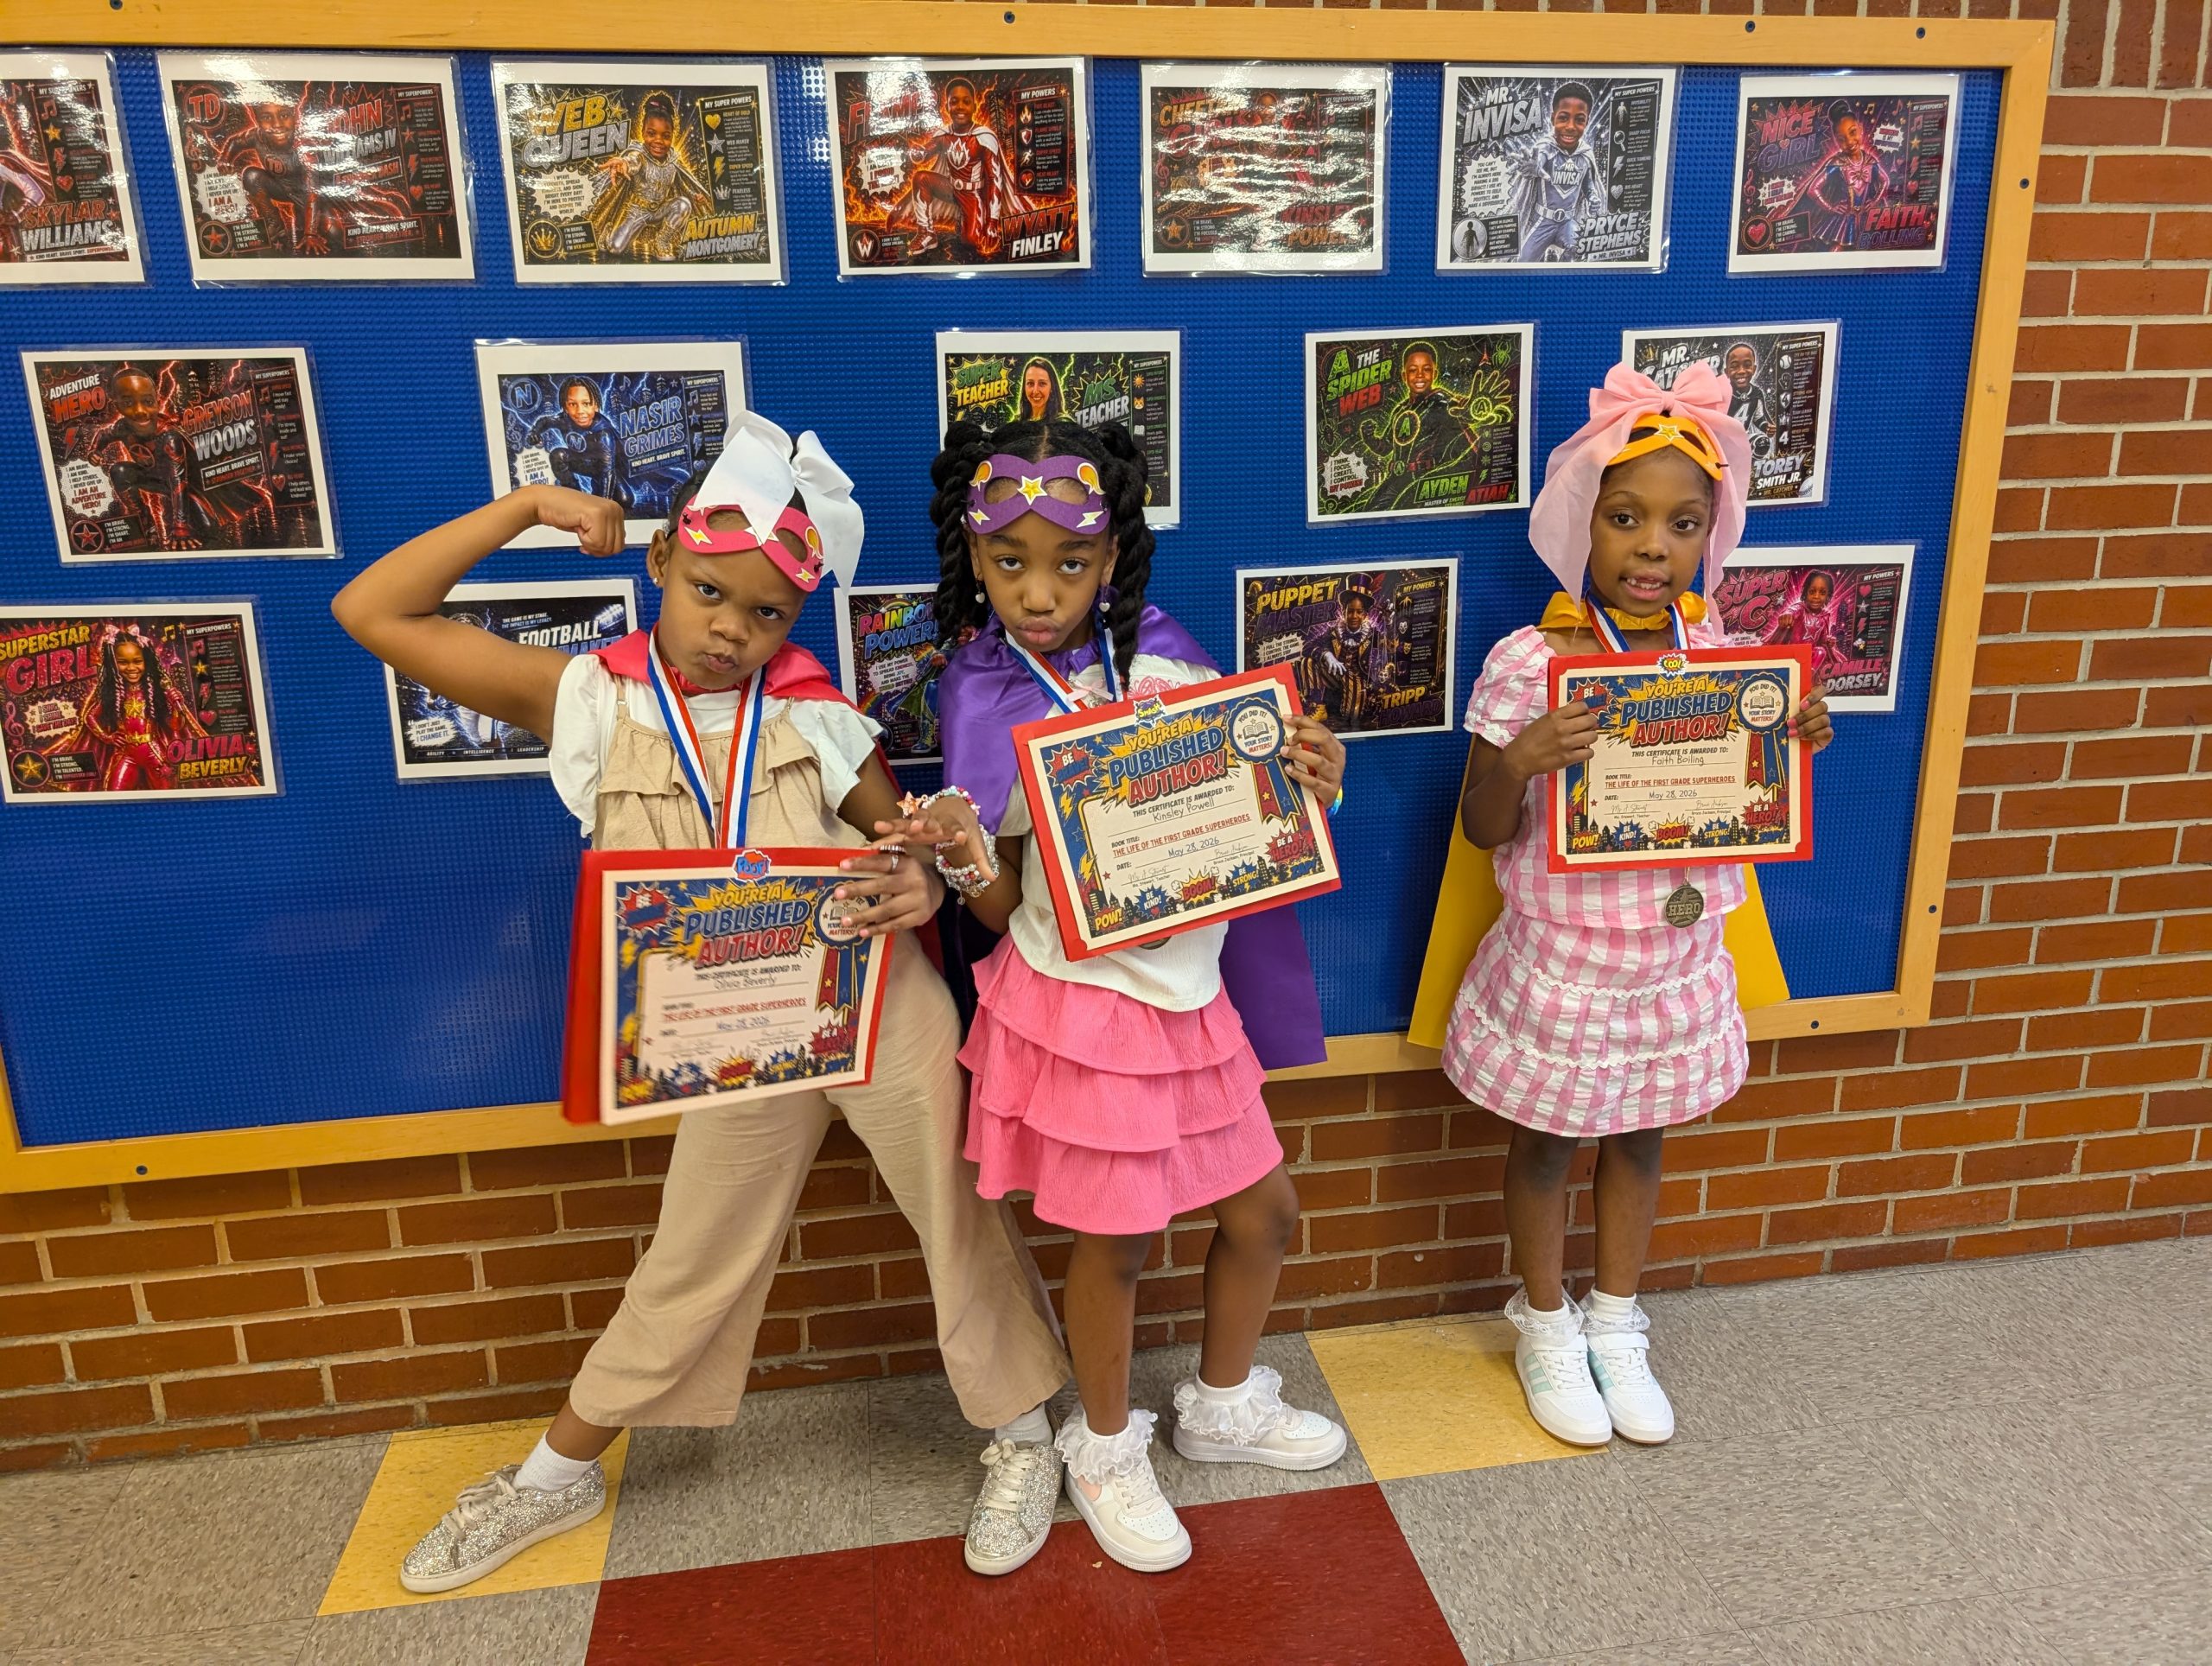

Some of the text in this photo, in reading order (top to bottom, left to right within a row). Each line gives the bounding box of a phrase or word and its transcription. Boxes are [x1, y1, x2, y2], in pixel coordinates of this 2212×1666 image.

[714, 99, 730, 107] SUPER
[731, 95, 752, 105] POWERS
[1020, 87, 1056, 99] MY POWERS
[1485, 86, 1512, 105] MR.
[188, 93, 220, 121] TD
[527, 94, 608, 136] WEB
[1463, 99, 1542, 144] INVISA
[1760, 110, 1815, 145] NICE
[385, 128, 397, 149] IV
[523, 122, 630, 168] QUEEN
[1553, 171, 1580, 186] INVISA
[24, 199, 105, 229] SKYLAR
[685, 214, 758, 240] AUTUMN
[1003, 206, 1073, 237] WYATT
[1584, 213, 1638, 237] PRYCE
[1866, 205, 1927, 231] FAITH
[21, 220, 113, 251] WILLIAMS
[686, 234, 760, 258] MONTGOMERY
[1012, 232, 1063, 258] FINLEY
[1577, 231, 1641, 253] STEPHENS
[1859, 226, 1926, 249] BOLLING
[1328, 348, 1351, 381] A
[1357, 348, 1381, 369] THE
[1662, 346, 1690, 368] MR.
[49, 373, 100, 400] ADVENTURE
[956, 361, 1002, 387] SUPER
[1326, 359, 1393, 402] SPIDER
[515, 385, 534, 408] N
[956, 379, 1009, 407] TEACHER
[1083, 378, 1121, 405] MS.
[1339, 384, 1382, 416] WEB
[54, 387, 107, 423] HERO
[181, 390, 253, 436] GREYSON
[620, 396, 683, 439] NASIR
[1075, 395, 1130, 429] TEACHER
[193, 418, 257, 461] WOODS
[624, 423, 684, 458] GRIMES
[1779, 431, 1789, 445] 4
[232, 461, 245, 470] BRAVE
[1754, 453, 1805, 478] TOREY
[1418, 474, 1469, 500] AYDEN
[1757, 472, 1802, 489] SMITH JR.
[1465, 484, 1510, 505] ATIAH
[1403, 581, 1436, 593] MY POWERS
[1719, 570, 1789, 607] SUPER
[1864, 570, 1894, 582] MY POWERS
[1255, 580, 1338, 614] PUPPET
[1255, 601, 1338, 638] MASTER
[1739, 595, 1770, 629] C
[195, 623, 232, 634] SUPERPOWERS
[518, 620, 601, 647] FOOTBALL
[865, 621, 938, 658] POWER!
[0, 626, 91, 661] SUPERSTAR
[5, 645, 99, 695] GIRL
[1821, 658, 1883, 678] CAMILLE
[1584, 687, 1594, 698] BE
[1646, 677, 1707, 698] YOU'RE A
[1827, 673, 1881, 692] DORSEY
[1383, 686, 1426, 709] TRIPP
[1619, 691, 1732, 727] PUBLISHED
[1238, 712, 1249, 722] YOU
[1384, 698, 1442, 725] HOWARD
[1128, 718, 1193, 751] YOU'RE A
[1244, 734, 1273, 747] YOUR STORY
[1630, 713, 1730, 747] AUTHOR!
[168, 734, 245, 762] OLIVIA
[1062, 752, 1074, 766] BE
[1107, 726, 1224, 787] PUBLISHED
[1249, 743, 1273, 754] MATTERS!
[1652, 754, 1674, 766] Faith
[179, 756, 247, 779] BEVERLY
[1128, 749, 1225, 805] AUTHOR!
[1133, 809, 1147, 817] THIS
[1147, 798, 1185, 814] CERTIFICATE
[1194, 787, 1224, 801] AWARDED
[1224, 785, 1235, 793] TO:
[1649, 791, 1663, 800] May
[1679, 789, 1697, 798] 2026
[1153, 796, 1215, 822] Kinsley Powell
[1111, 836, 1140, 849] BOOK TITLE:
[1113, 813, 1250, 857] THE LIFE OF THE FIRST GRADE SUPERHEROES
[1168, 847, 1184, 857] May
[1199, 836, 1220, 849] 2026
[1573, 833, 1599, 849] POW!
[1619, 830, 1637, 841] KIND!
[1656, 825, 1689, 842] BOOM!
[1271, 841, 1303, 862] HERO!
[1116, 862, 1132, 871] DATE:
[1232, 870, 1258, 887] STRONG!
[712, 884, 782, 907] YOU'RE A
[1144, 894, 1162, 910] KIND!
[1146, 890, 1154, 900] BE
[1182, 876, 1217, 902] BOOM!
[684, 900, 810, 944] PUBLISHED
[1095, 907, 1122, 932] POW!
[1668, 902, 1700, 917] HERO
[694, 925, 805, 970] AUTHOR!
